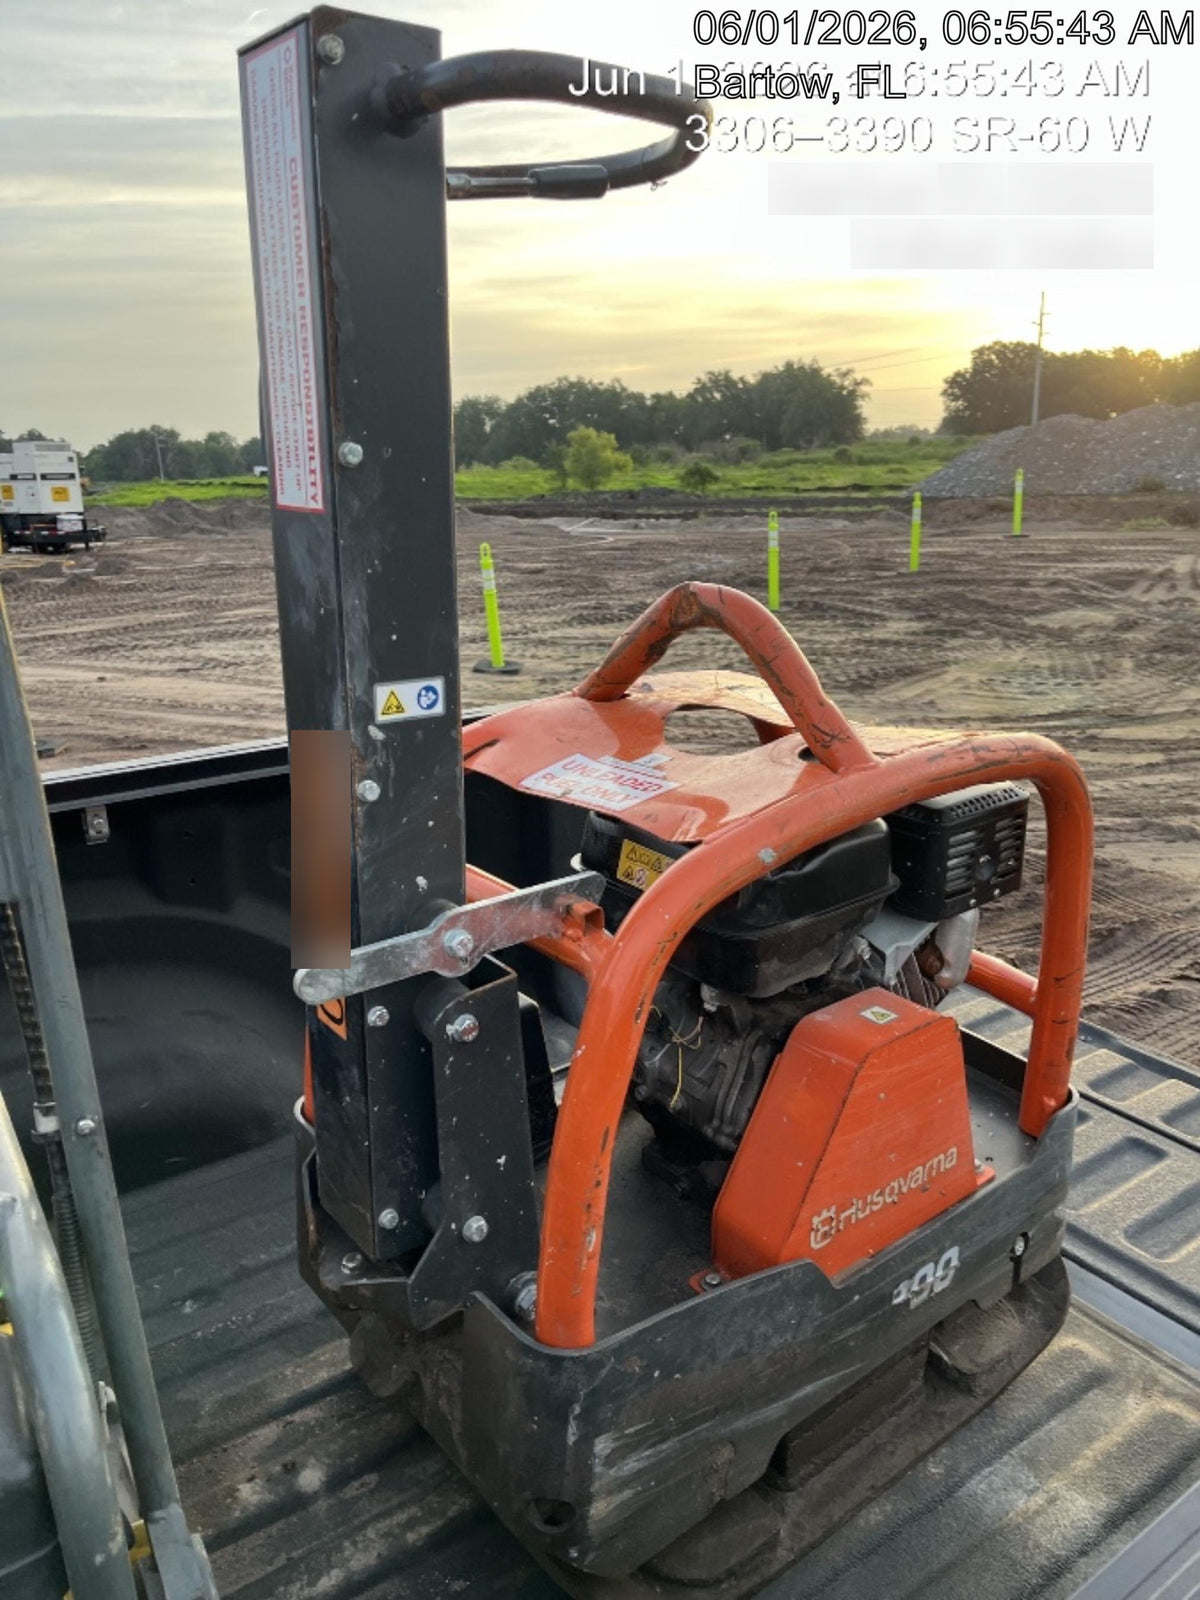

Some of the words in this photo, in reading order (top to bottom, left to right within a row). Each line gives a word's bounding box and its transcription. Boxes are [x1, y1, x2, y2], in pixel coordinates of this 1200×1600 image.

[289, 157, 305, 298] CUSTOMER
[298, 305, 317, 504] RESPONSIBILITY
[562, 759, 664, 793] UNLEADED
[838, 1146, 958, 1230] Husqvarna
